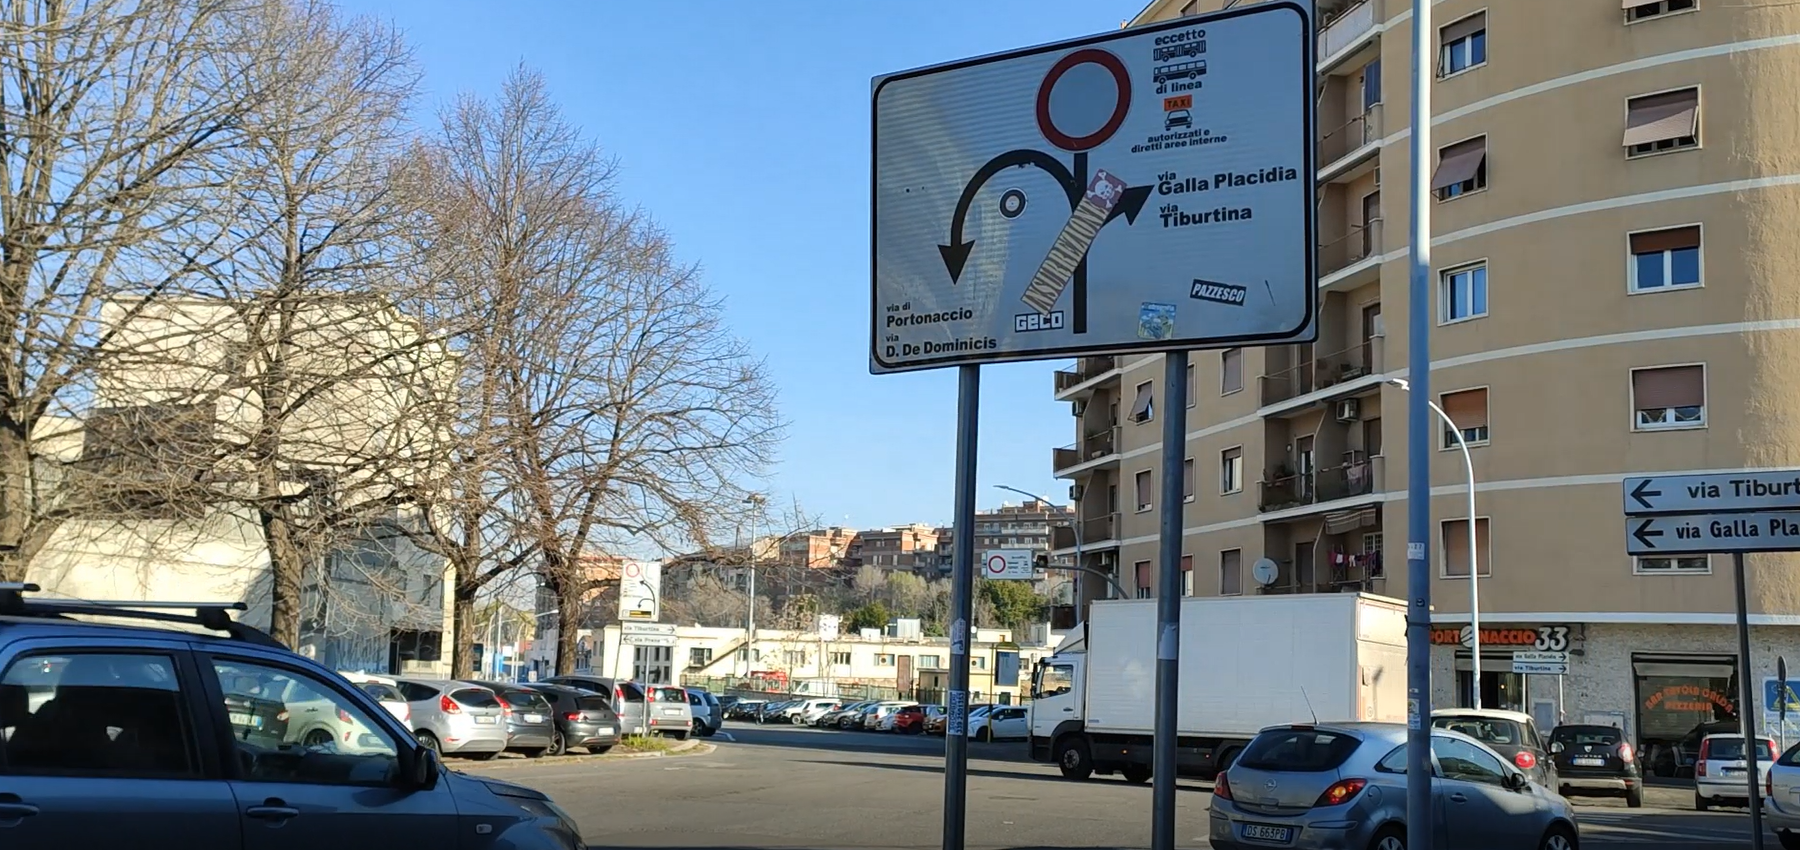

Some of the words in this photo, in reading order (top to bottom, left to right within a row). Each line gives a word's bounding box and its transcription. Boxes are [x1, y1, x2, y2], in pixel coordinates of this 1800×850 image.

[1154, 29, 1206, 46] eccetto
[1155, 83, 1167, 95] di
[1171, 80, 1203, 92] linea
[1167, 97, 1190, 108] TAXI
[1131, 141, 1162, 153] diretti
[1164, 140, 1187, 150] aree
[1189, 135, 1228, 147] interne
[1147, 128, 1202, 143] autorizzati
[1203, 129, 1210, 137] e
[1157, 171, 1177, 182] via
[1157, 177, 1209, 196] Galla
[1214, 166, 1297, 189] Placidia
[1159, 203, 1179, 214] via
[1159, 207, 1252, 228] Tiburtina
[1192, 283, 1245, 302] PAZZESCO
[886, 303, 900, 313] via
[901, 302, 911, 311] di
[886, 307, 973, 328] Portonaccio
[885, 333, 900, 343] via
[885, 345, 900, 358] D.
[902, 342, 921, 357] De
[923, 336, 997, 354] Dominicis
[1687, 481, 1720, 498] via
[1729, 477, 1800, 497] Tiburt
[1675, 522, 1701, 539] via
[1709, 519, 1759, 538] Galla
[1769, 518, 1800, 536] Pla
[1535, 626, 1569, 651] 33
[1247, 825, 1258, 837] DS
